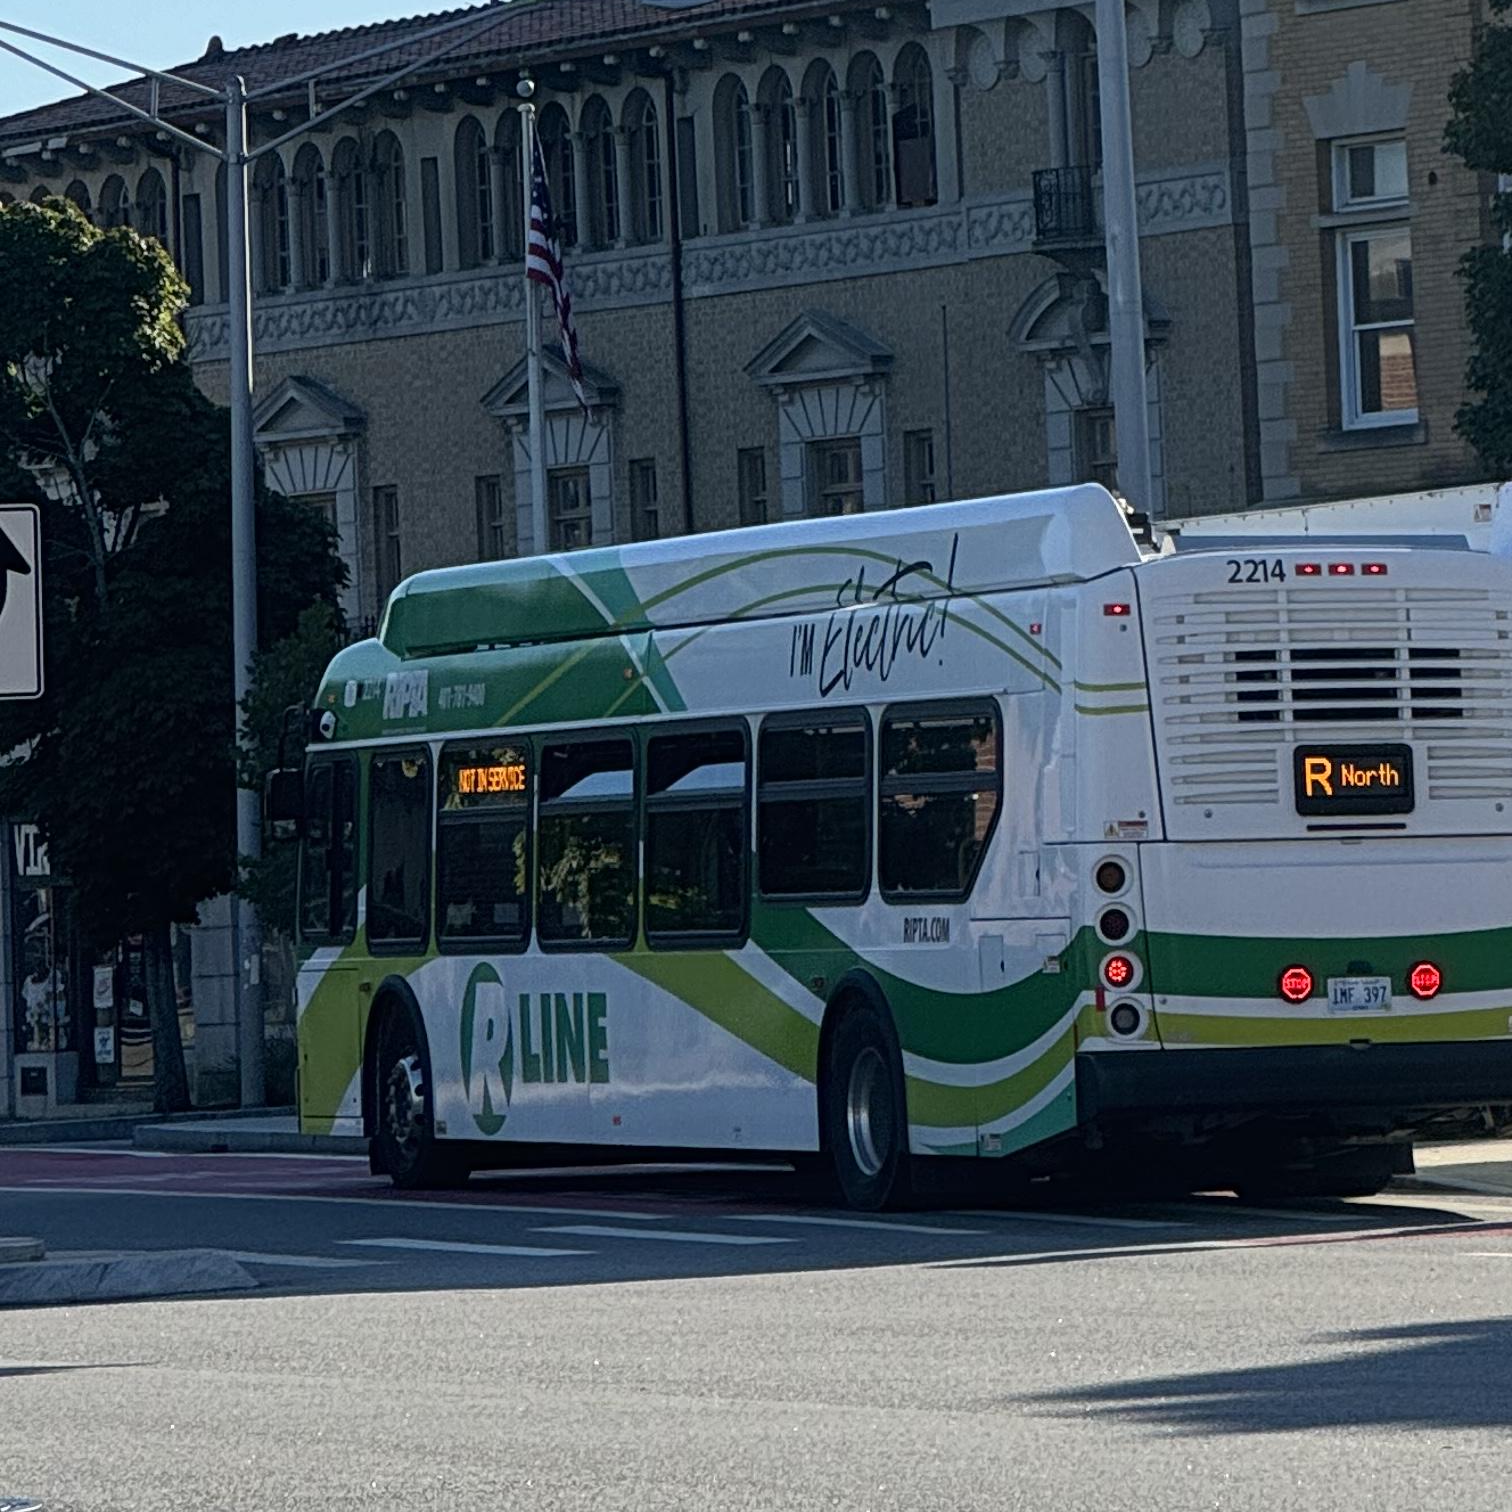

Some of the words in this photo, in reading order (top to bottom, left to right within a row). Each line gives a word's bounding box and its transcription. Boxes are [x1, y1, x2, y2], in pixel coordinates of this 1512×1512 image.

[1226, 559, 1286, 583] 2214
[382, 669, 429, 720] RIPTA
[459, 769, 475, 793] NOT
[1305, 757, 1333, 797] R
[1341, 763, 1399, 787] North
[903, 916, 951, 944] RIPTA.COM
[1363, 985, 1387, 1004] 397
[466, 978, 512, 1118] R
[519, 992, 610, 1085] LINE
